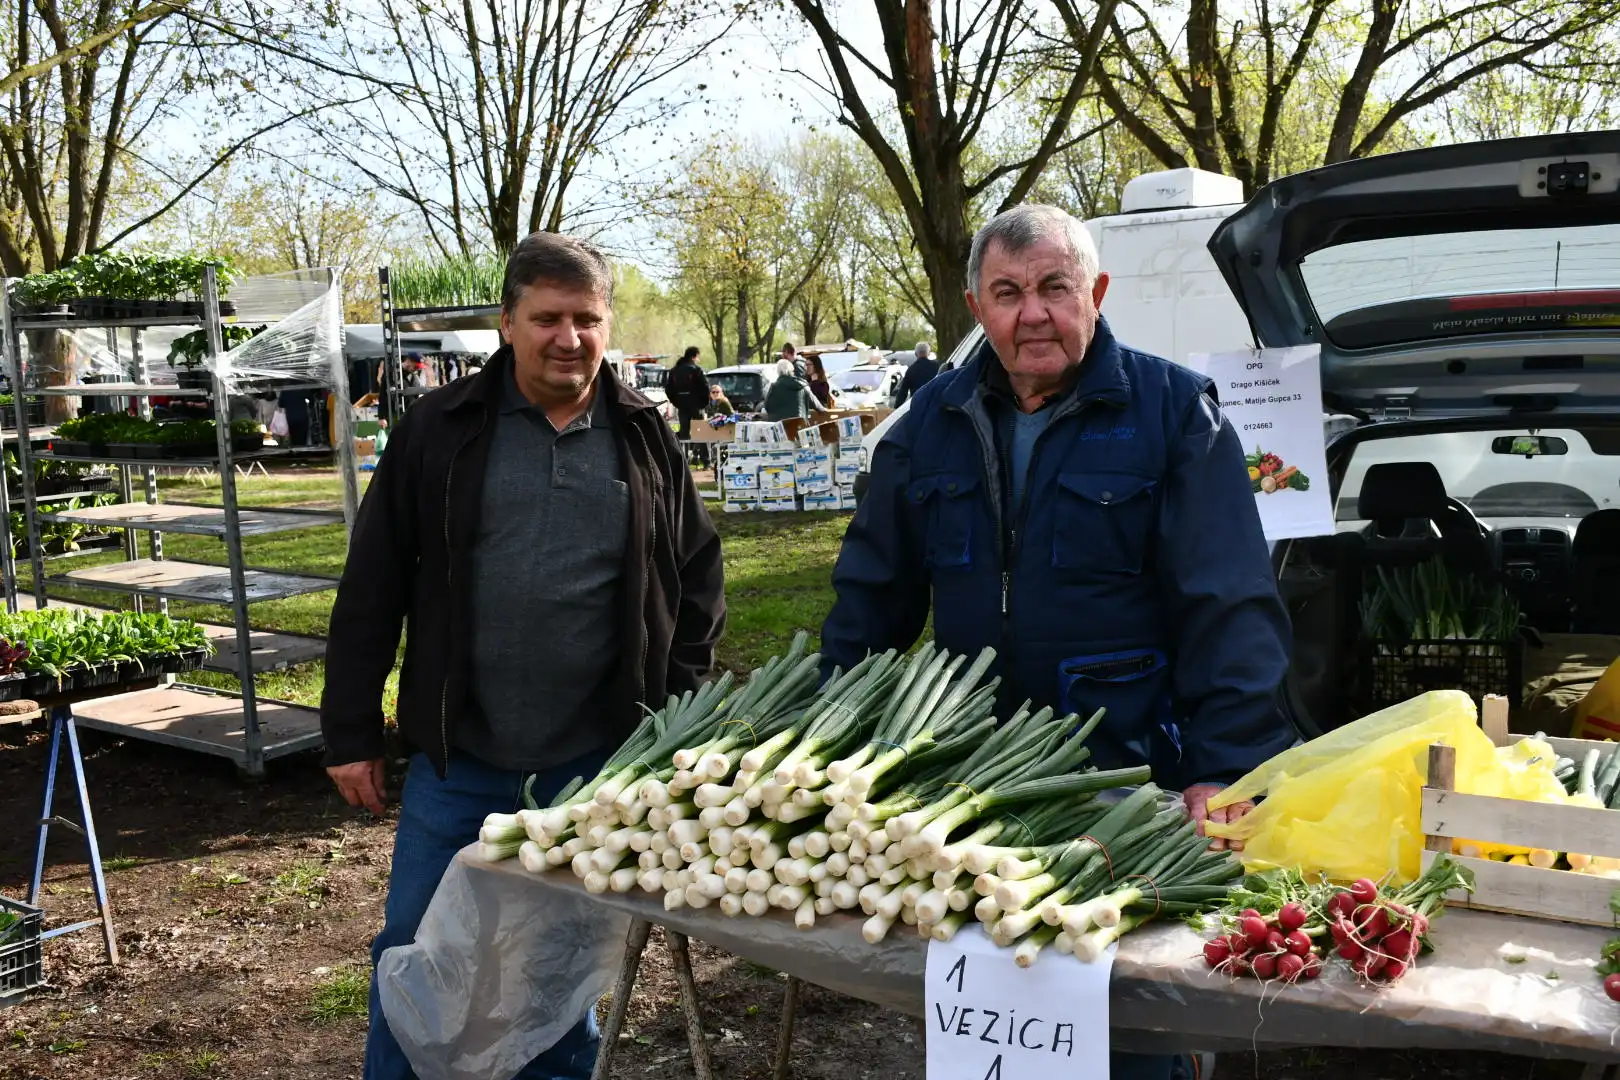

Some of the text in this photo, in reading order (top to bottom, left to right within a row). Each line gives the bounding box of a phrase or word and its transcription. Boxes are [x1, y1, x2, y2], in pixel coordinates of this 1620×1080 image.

[1246, 362, 1263, 370] OPG
[1254, 378, 1281, 387] Kišiček
[1218, 393, 1302, 408] ojanec, Matije Gupca 33
[946, 954, 967, 993] 1
